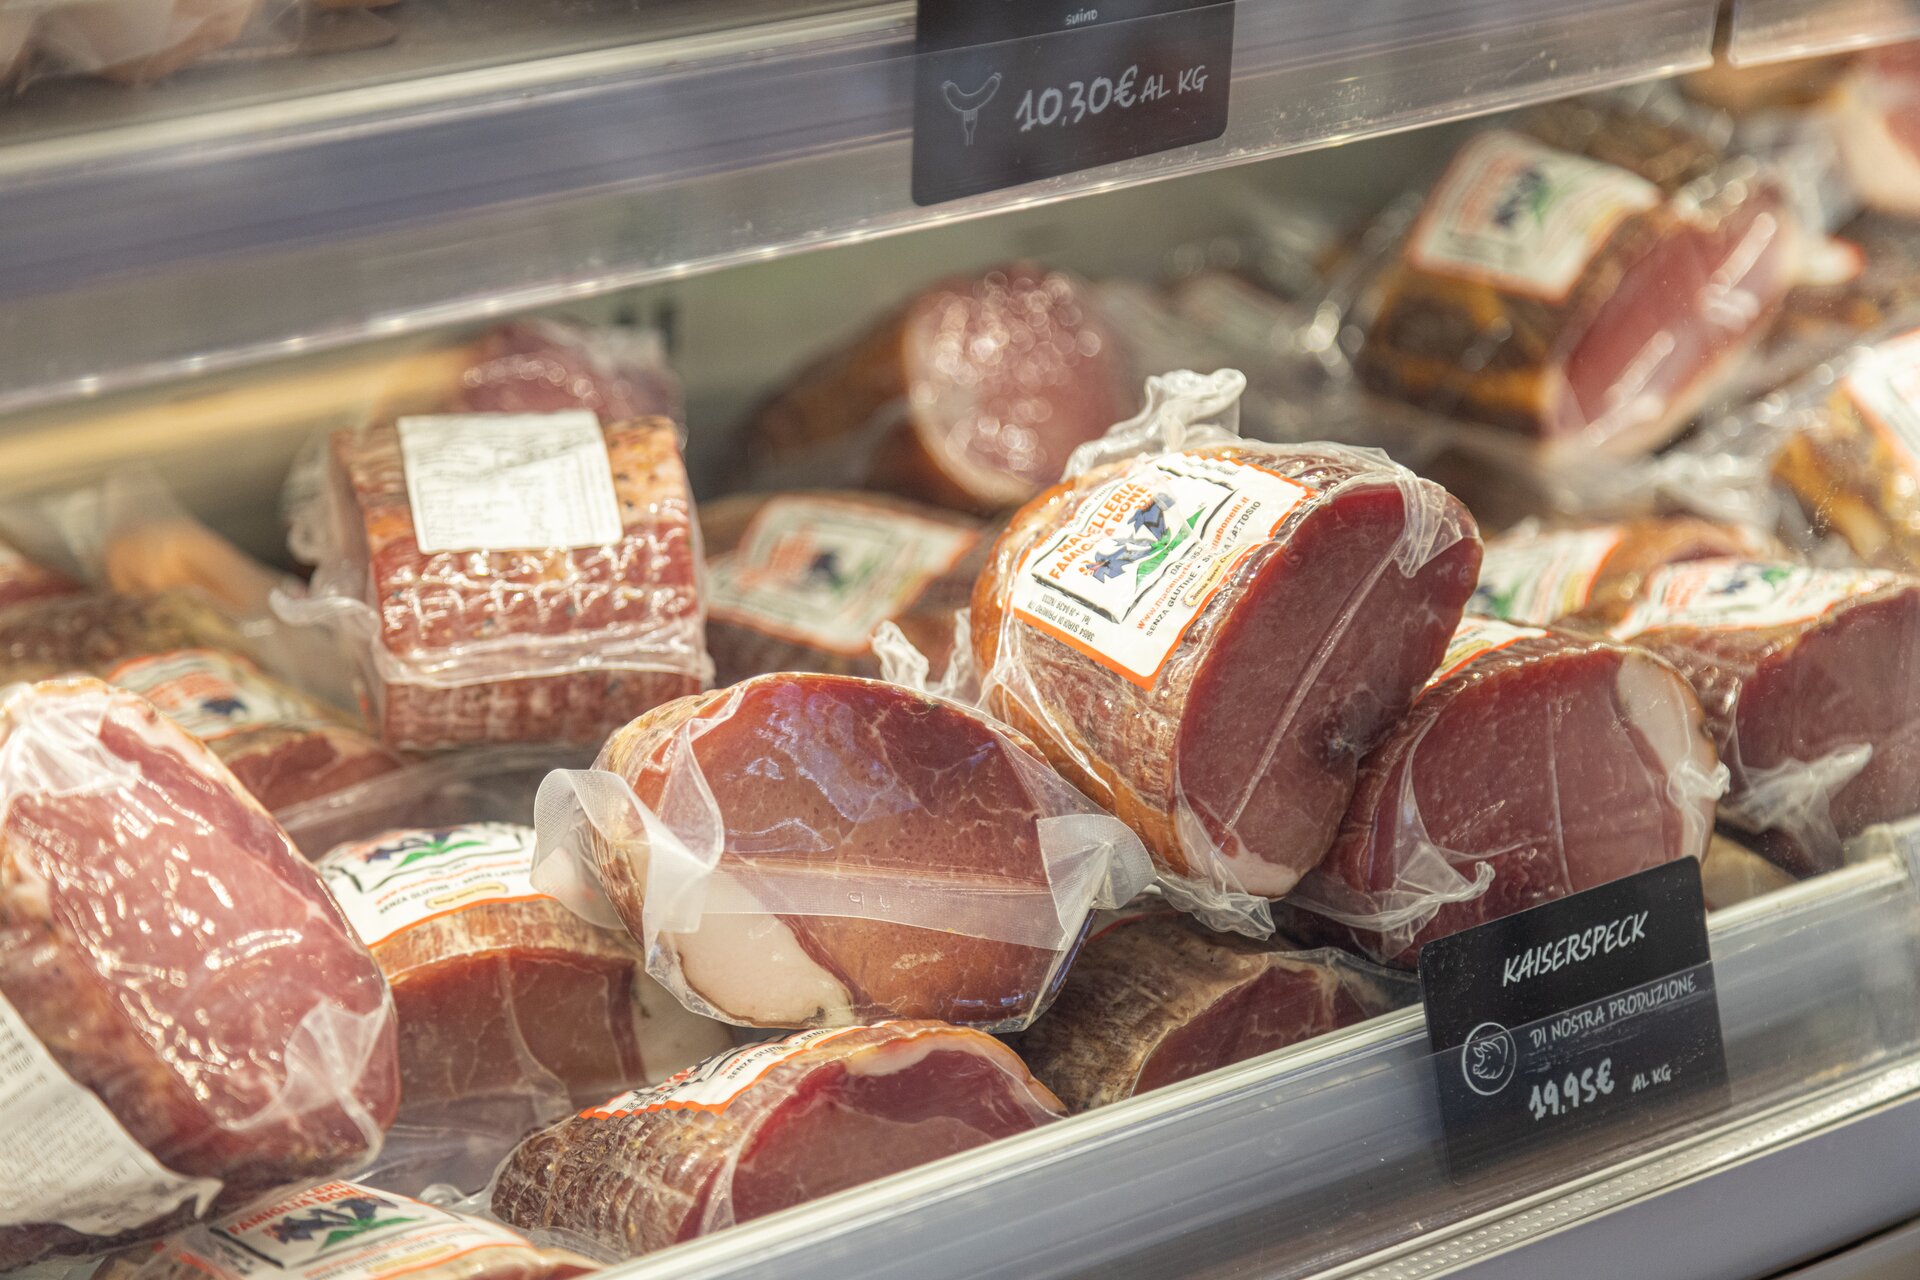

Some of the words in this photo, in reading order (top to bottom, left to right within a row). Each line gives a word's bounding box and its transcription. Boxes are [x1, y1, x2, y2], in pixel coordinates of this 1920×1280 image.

[1065, 8, 1098, 26] suino
[1015, 64, 1139, 132] 10,30€
[1140, 74, 1171, 103] AL
[1178, 65, 1208, 95] KG
[1502, 911, 1649, 987] KAISERSPECK
[1530, 1028, 1547, 1048] DI
[1551, 1006, 1605, 1040] NOSTRA
[1609, 973, 1697, 1018] PRODUZIONE
[1632, 1073, 1649, 1092] AL
[1652, 1064, 1672, 1084] KG
